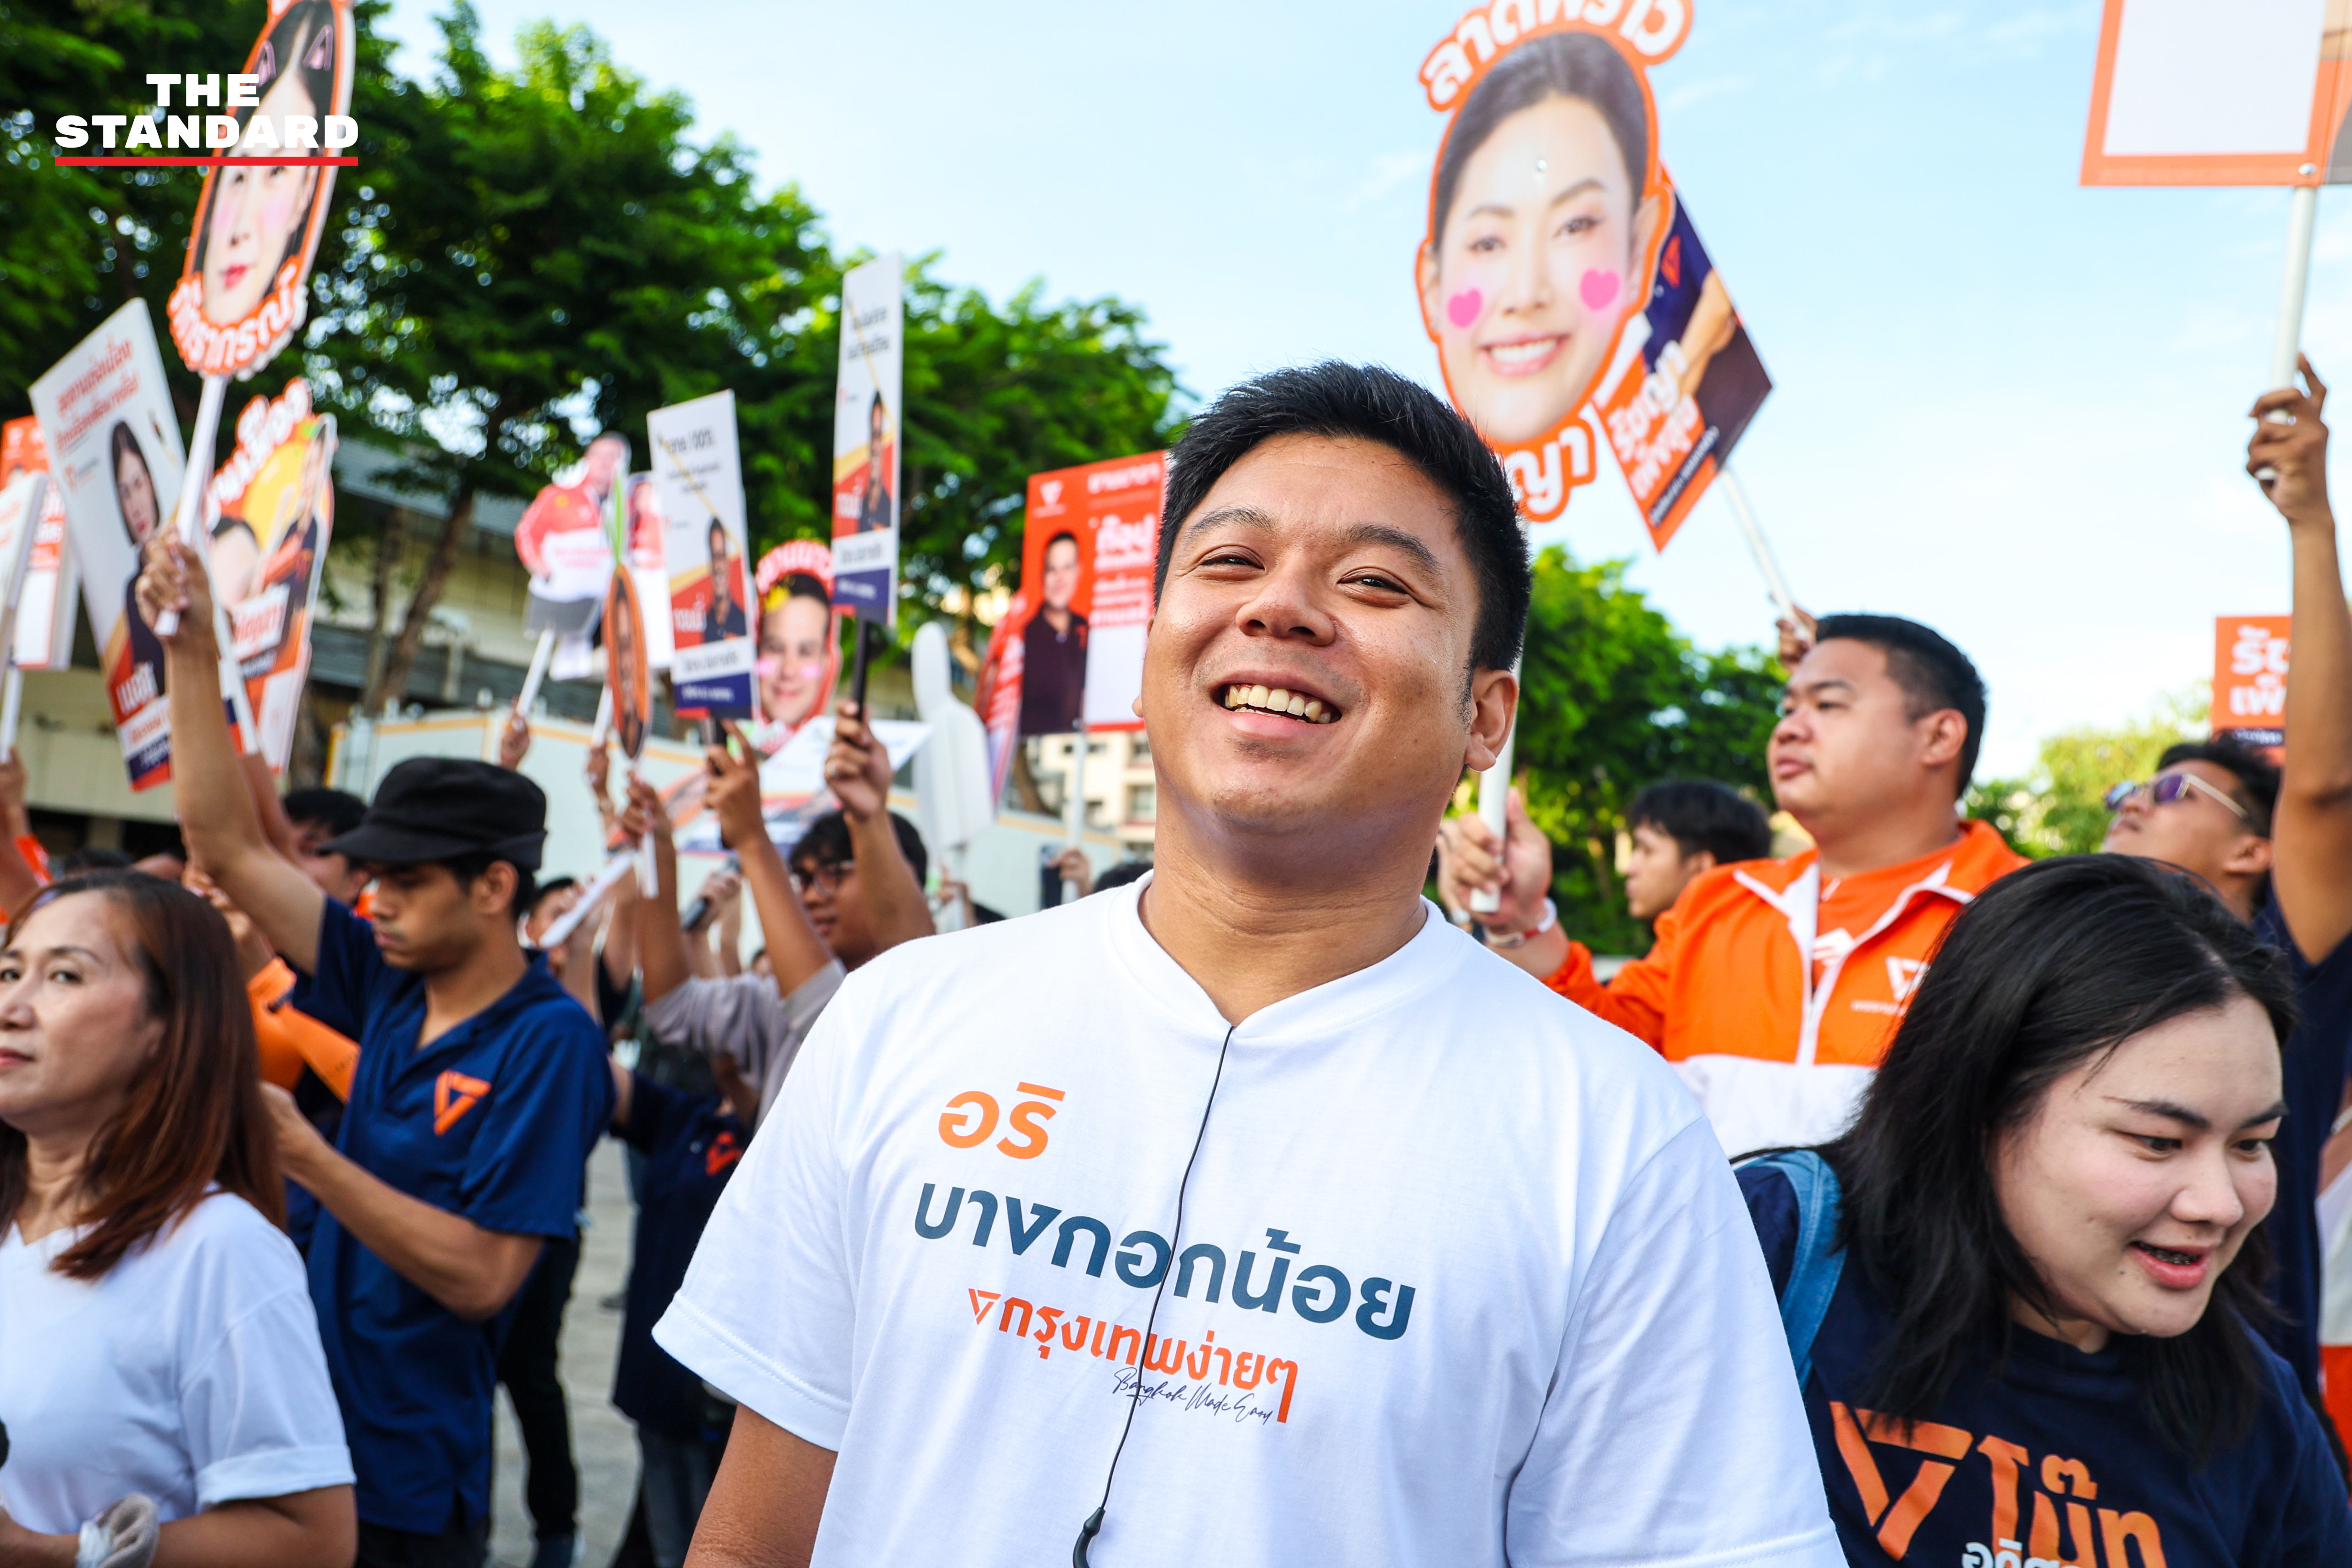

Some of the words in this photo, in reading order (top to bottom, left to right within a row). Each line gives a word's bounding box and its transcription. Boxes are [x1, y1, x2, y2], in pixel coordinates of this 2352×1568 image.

[938, 1081, 1066, 1160] อริ
[914, 1183, 1416, 1340] บางกอกน้อย
[998, 1297, 1298, 1424] กรุงเทพง่ายๆ
[1113, 1367, 1187, 1407] Bangkok
[1185, 1383, 1231, 1416] Made
[1234, 1393, 1273, 1425] Easy
